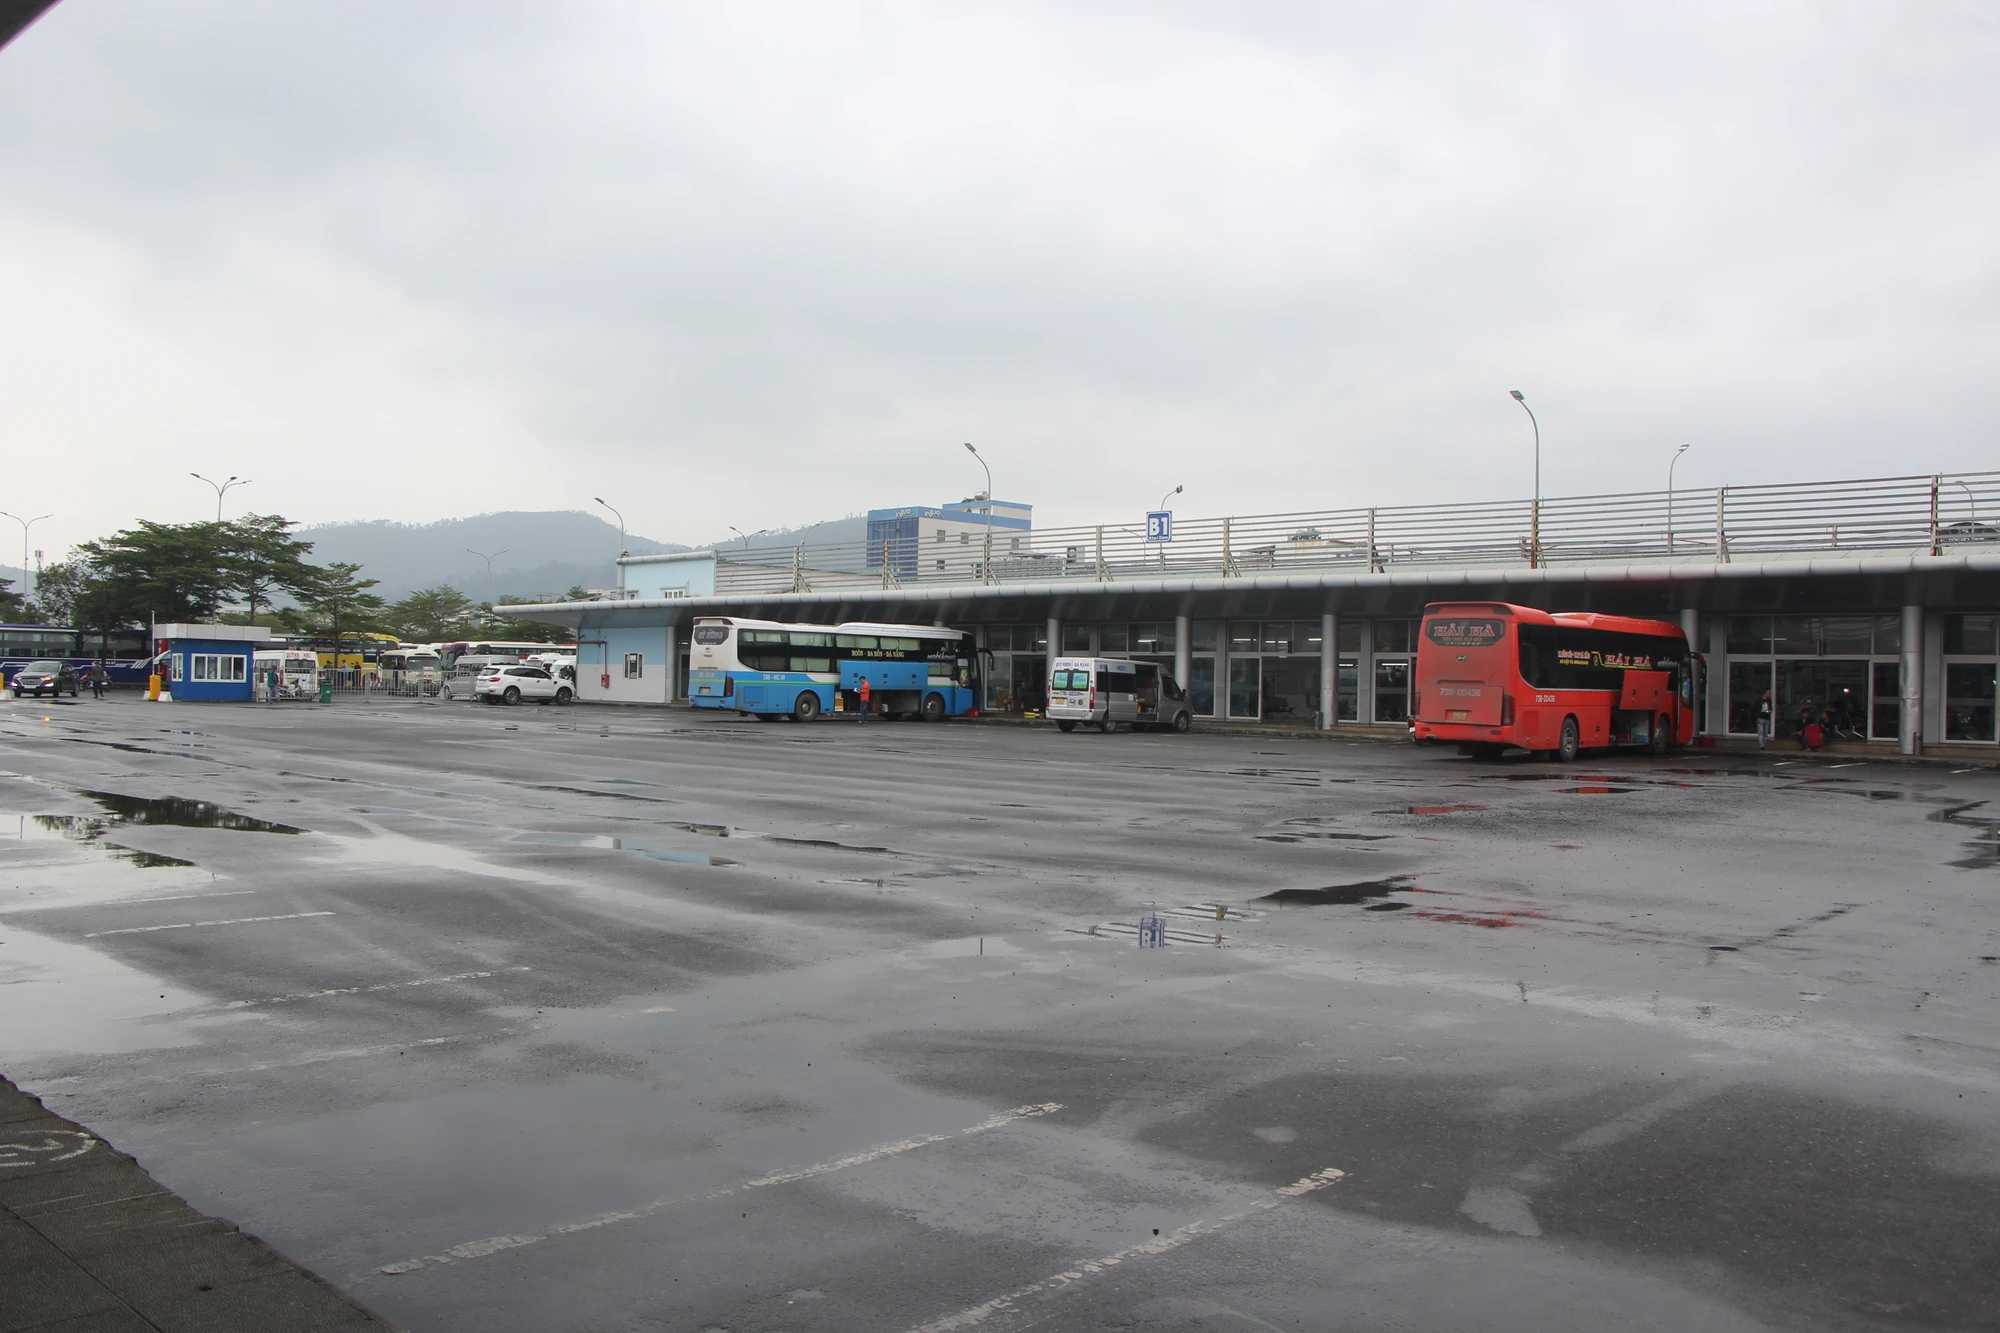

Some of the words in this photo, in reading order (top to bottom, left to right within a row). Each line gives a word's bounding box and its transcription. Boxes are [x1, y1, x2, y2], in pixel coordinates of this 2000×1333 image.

[1149, 517, 1168, 536] B1
[1434, 623, 1464, 636] HẢI
[1469, 624, 1495, 636] HÀ
[1605, 653, 1629, 665] HẢI
[1633, 655, 1651, 667] HÀ
